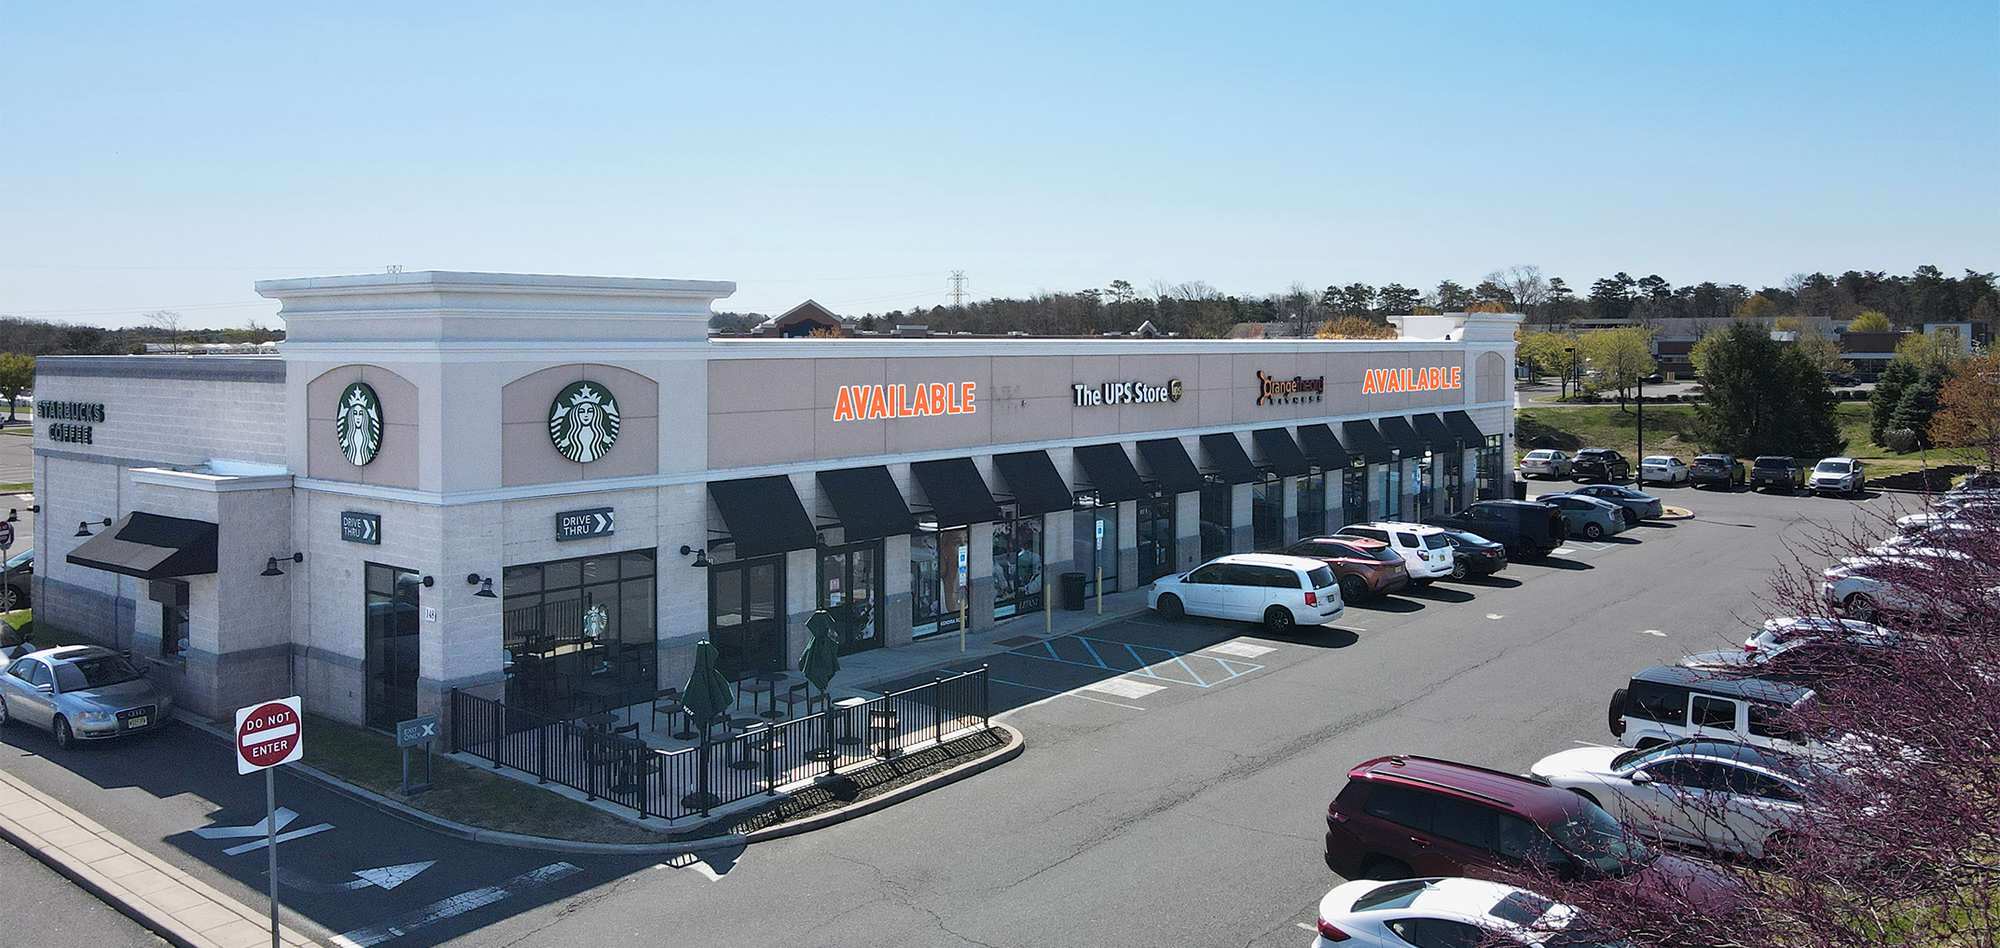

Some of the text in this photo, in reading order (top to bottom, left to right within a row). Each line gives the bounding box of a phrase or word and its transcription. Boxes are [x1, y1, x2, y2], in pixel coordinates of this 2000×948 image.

[1074, 382, 1168, 406] The UPS Store
[37, 400, 105, 423] STARBUCKS
[343, 516, 361, 529] DRIVE
[563, 514, 591, 527] DRIVE
[343, 526, 361, 538] THRU
[563, 524, 590, 536] THRU
[247, 711, 291, 731] DO NOT
[252, 740, 288, 757] ENTER
